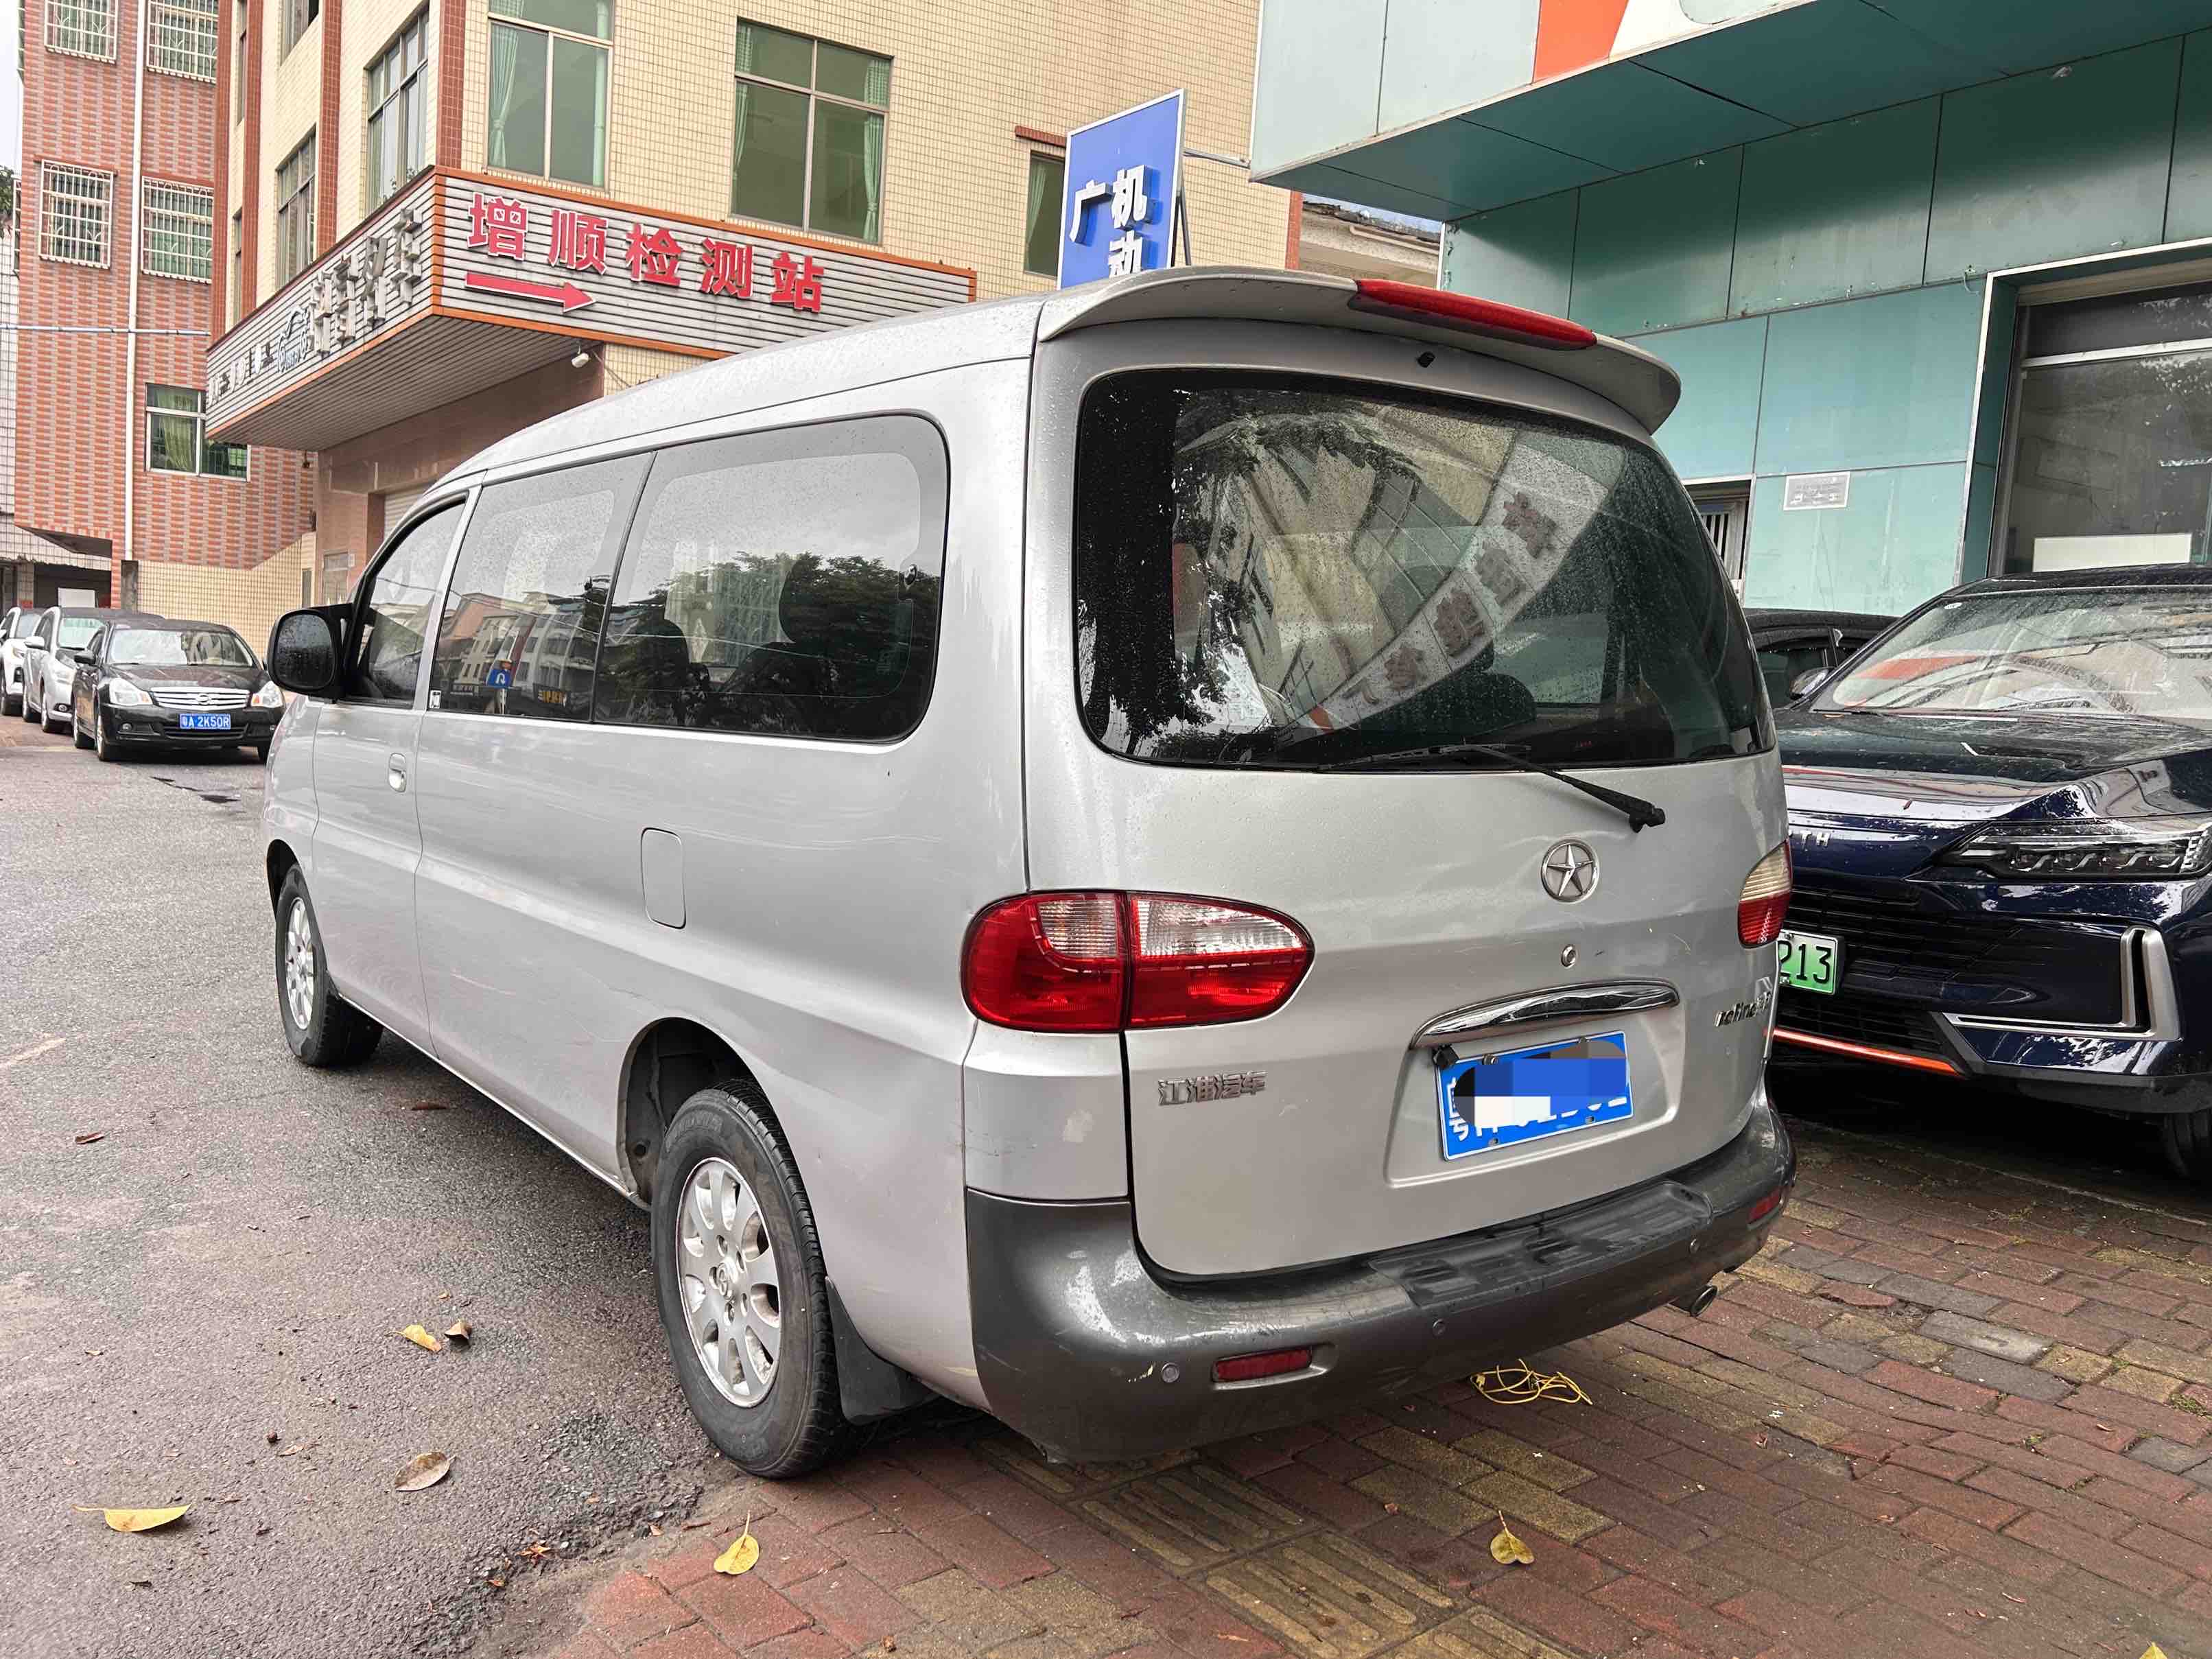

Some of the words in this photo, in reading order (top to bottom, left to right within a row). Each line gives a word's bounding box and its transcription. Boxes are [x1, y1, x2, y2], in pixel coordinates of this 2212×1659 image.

[465, 191, 825, 315] 增顺检测站
[1788, 829, 1831, 848] TH
[1778, 940, 1832, 985] 213
[1157, 1070, 1269, 1107] 江淮汽车
